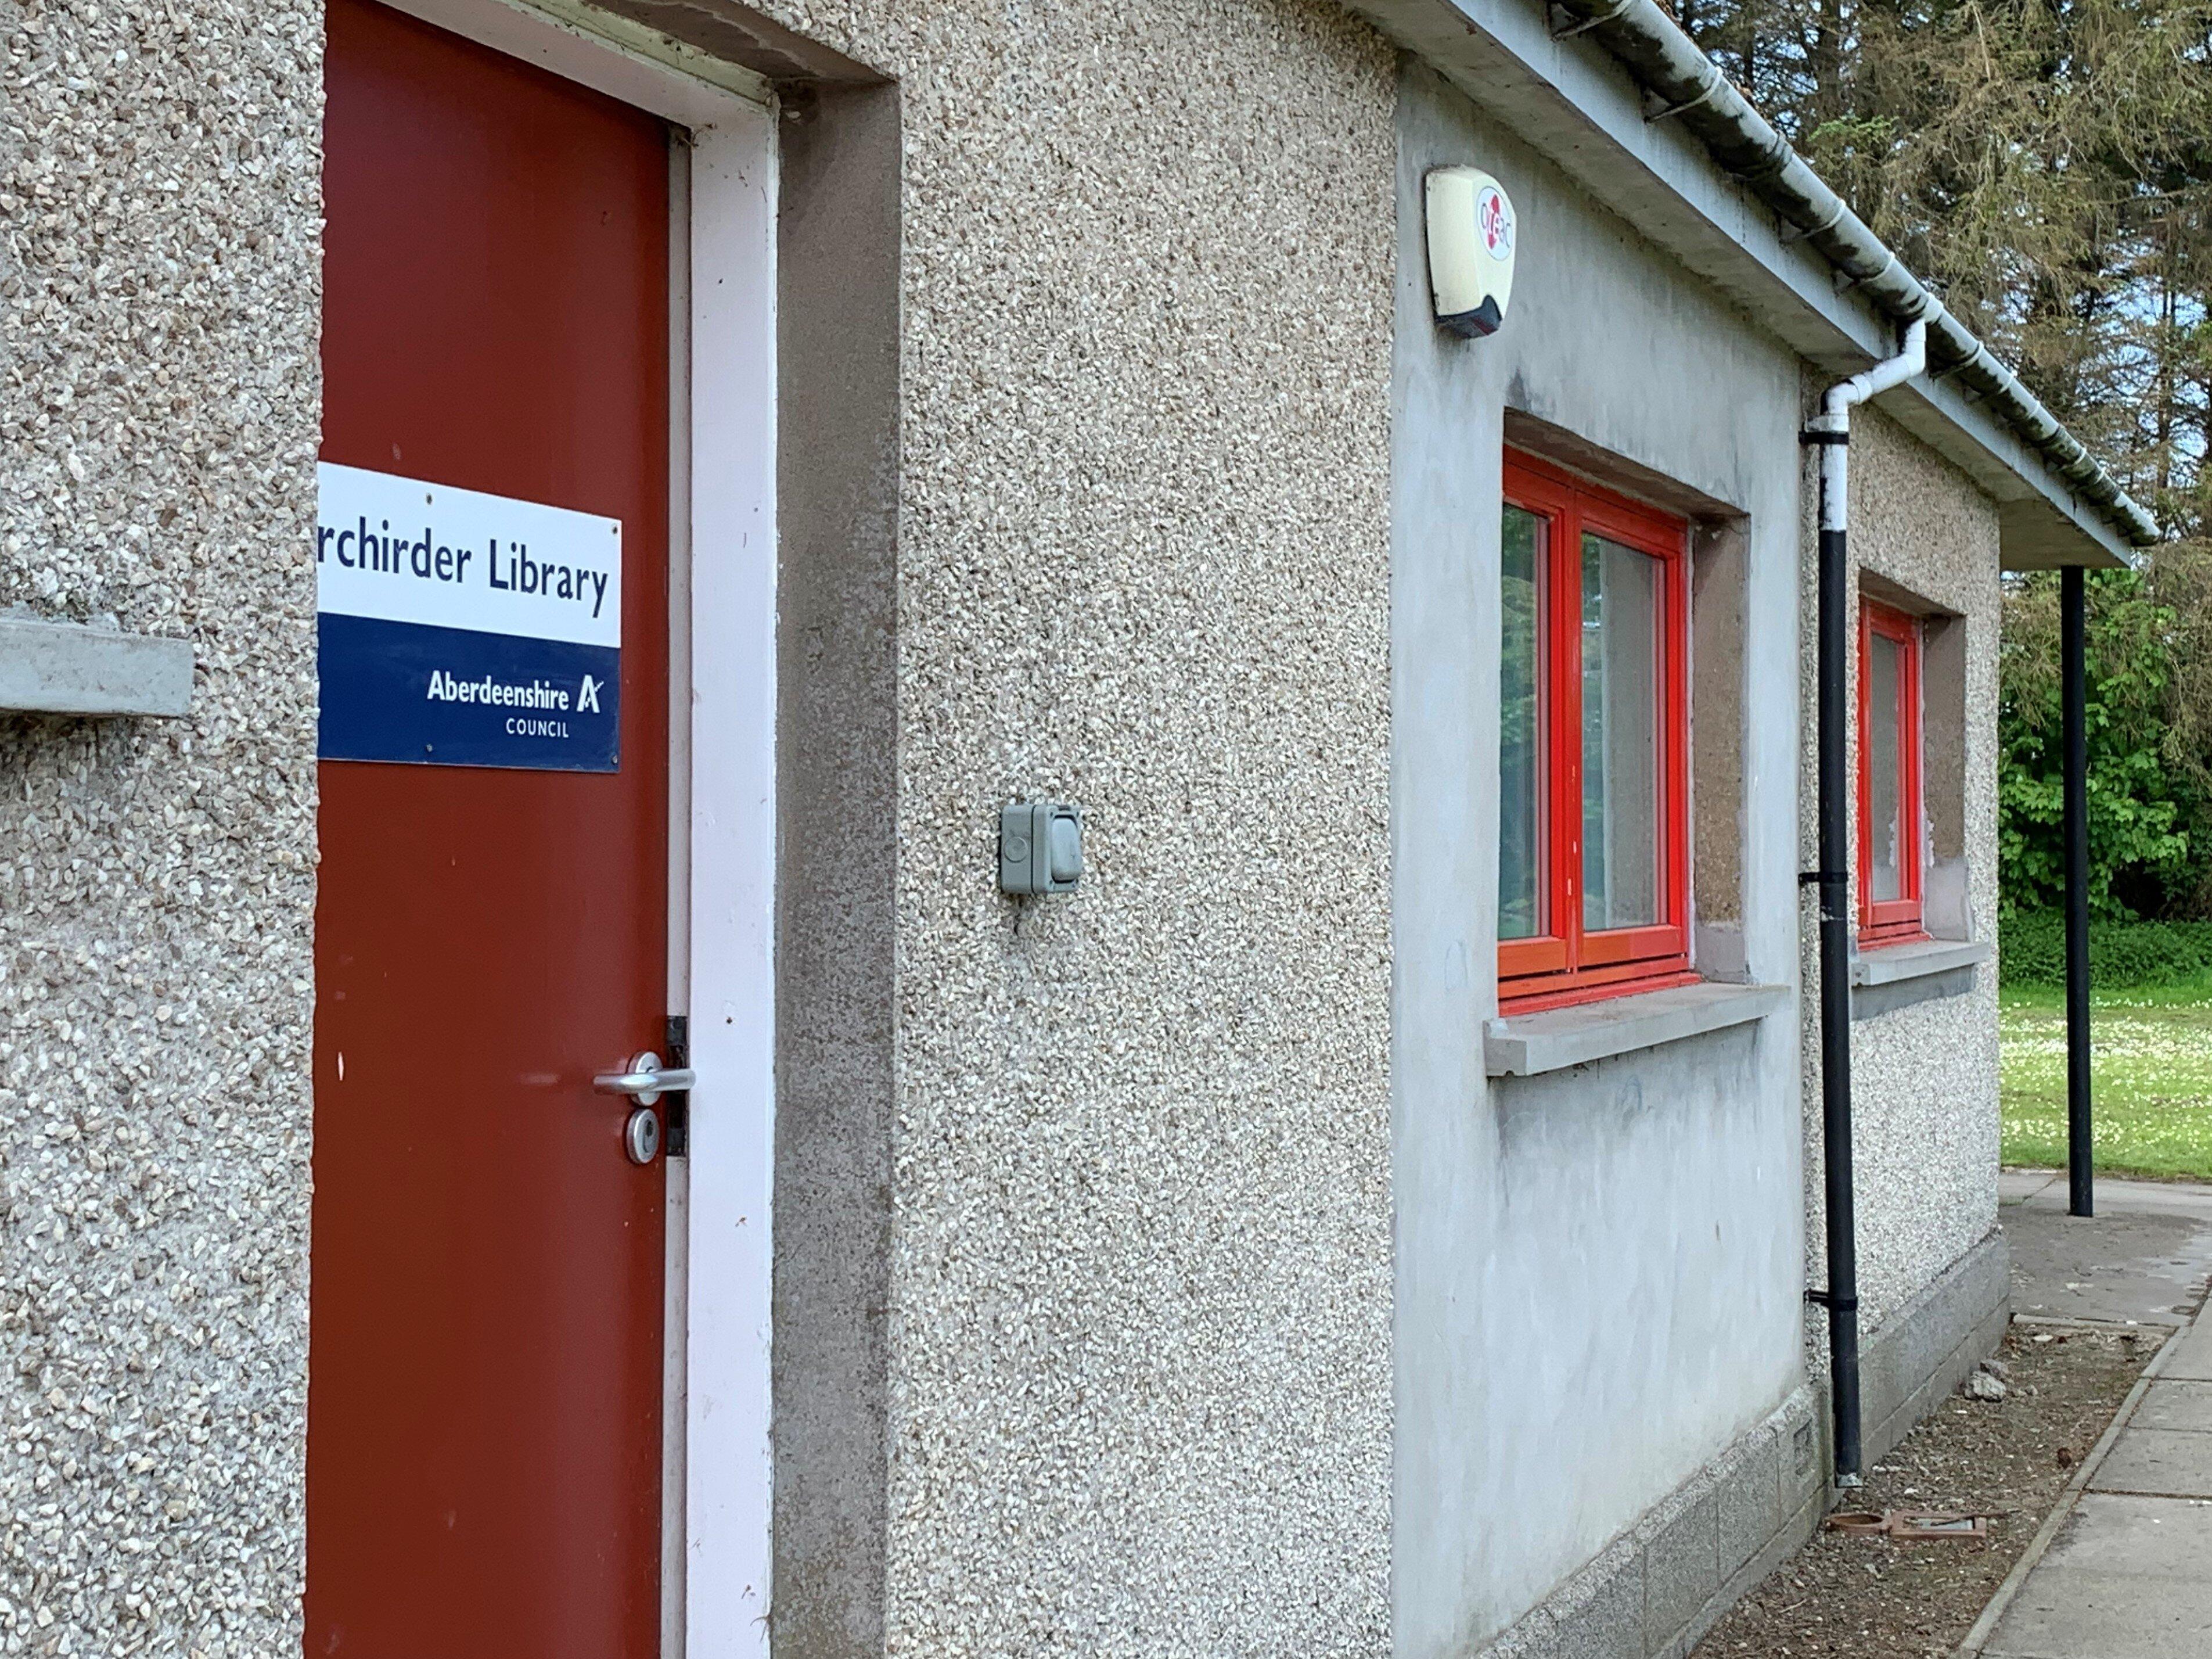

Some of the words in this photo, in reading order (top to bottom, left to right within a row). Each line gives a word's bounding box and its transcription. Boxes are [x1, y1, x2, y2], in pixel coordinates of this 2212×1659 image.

[490, 538, 608, 618] Library
[427, 670, 569, 710] Aberdeenshire
[506, 718, 569, 738] COUNCIL
